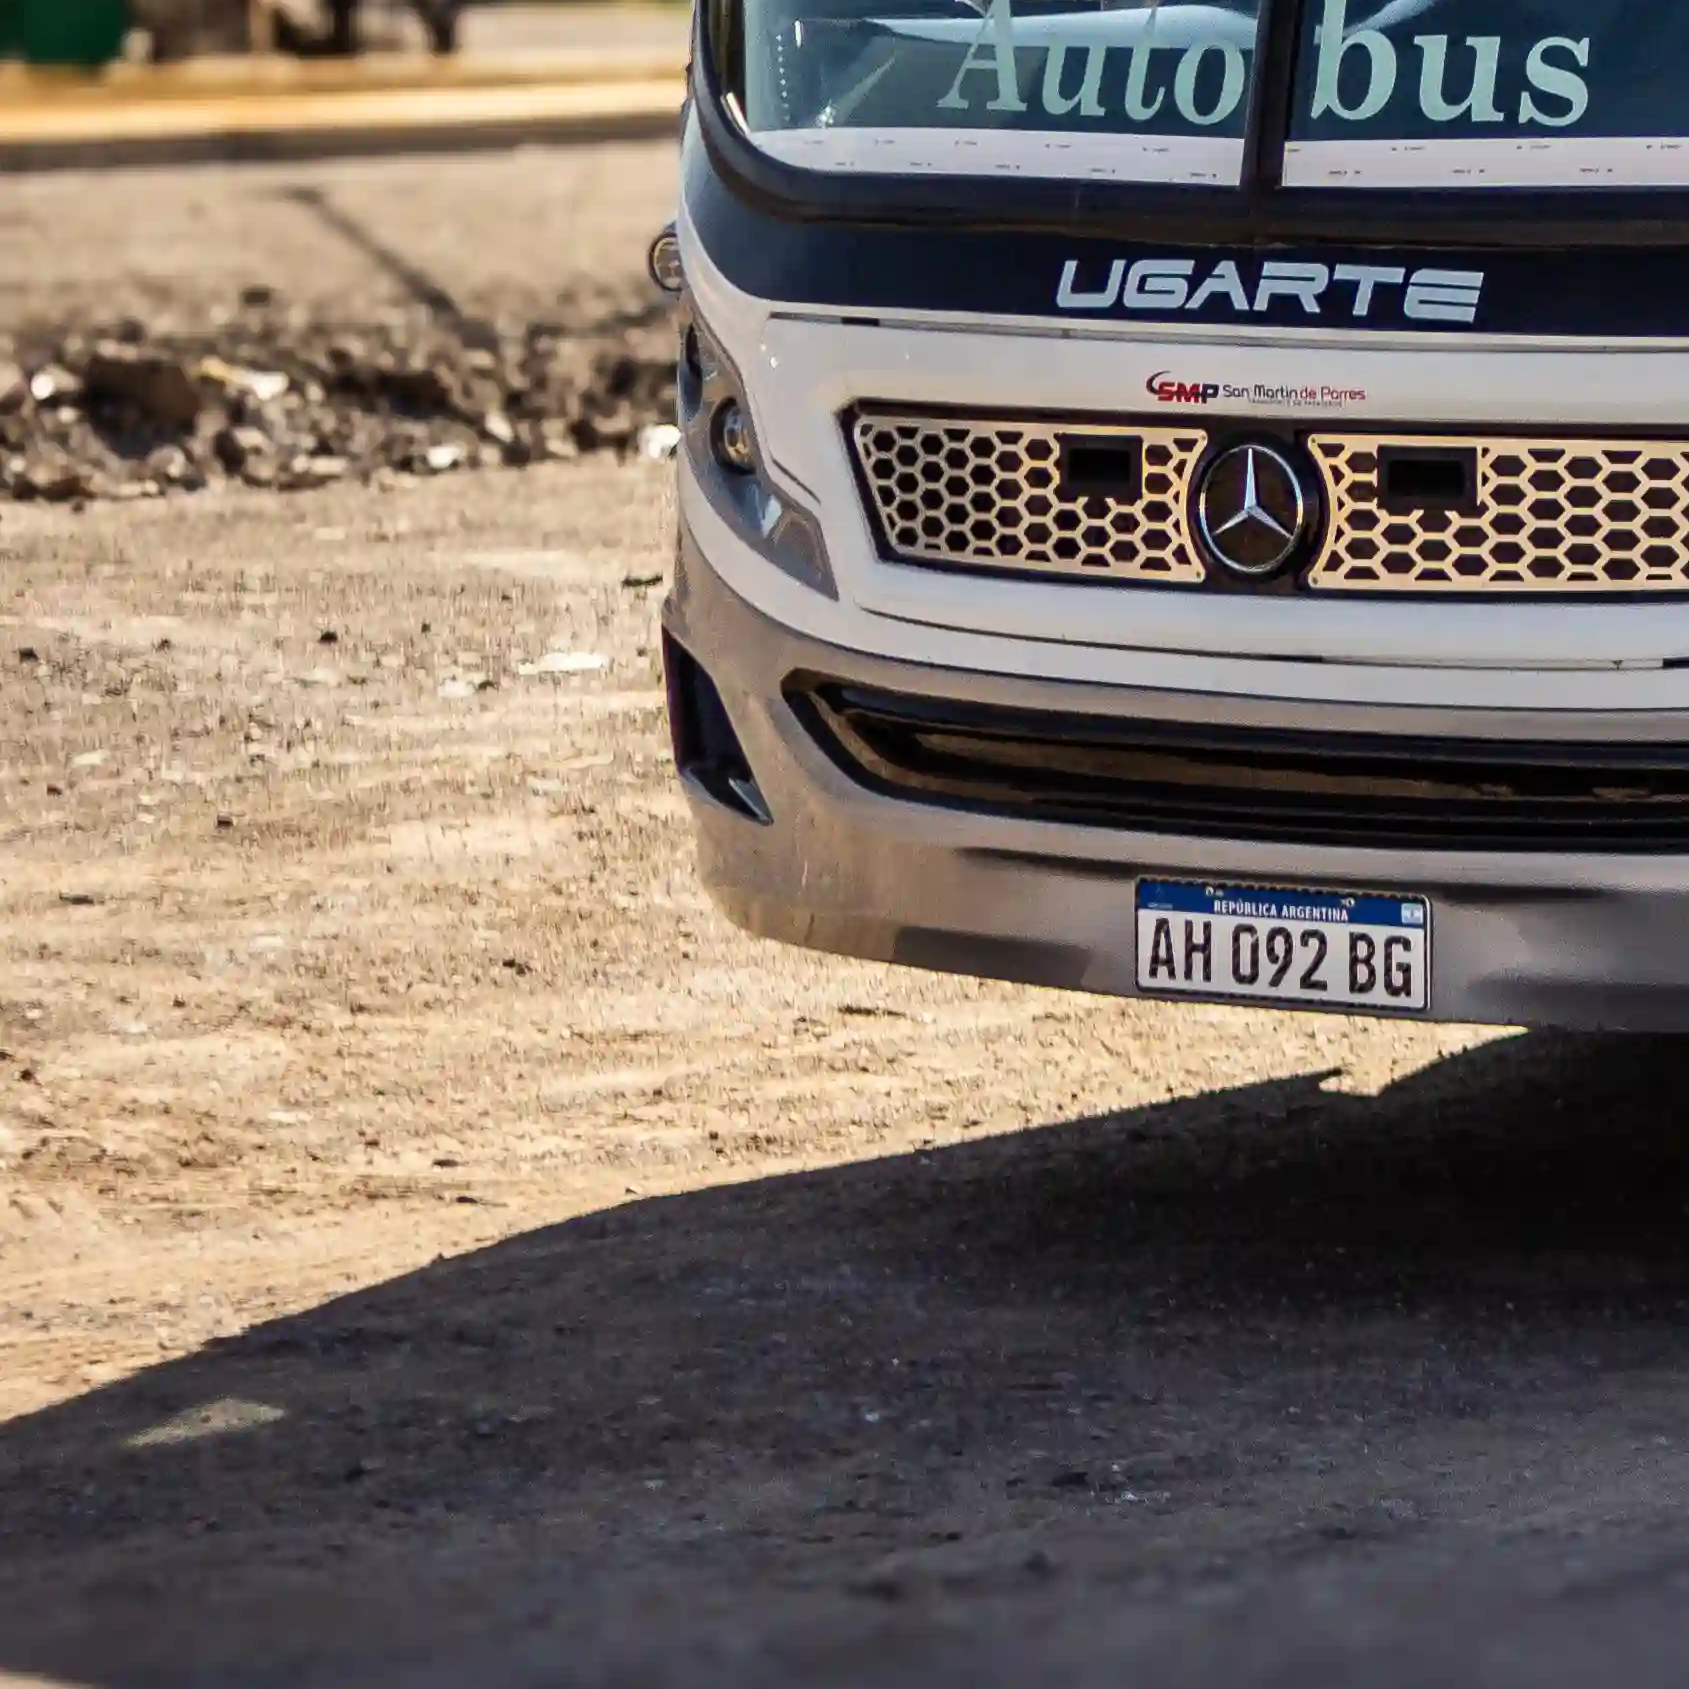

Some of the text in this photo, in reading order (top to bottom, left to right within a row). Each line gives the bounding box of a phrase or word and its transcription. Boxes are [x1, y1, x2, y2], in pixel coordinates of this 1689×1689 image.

[1056, 258, 1485, 324] UGARTE
[1156, 381, 1219, 403] SMP
[1223, 384, 1250, 398] San
[1300, 386, 1317, 400] de
[1320, 386, 1367, 400] Porres
[1281, 903, 1349, 923] ARGENTINA
[1148, 917, 1412, 998] AH 092 BG
